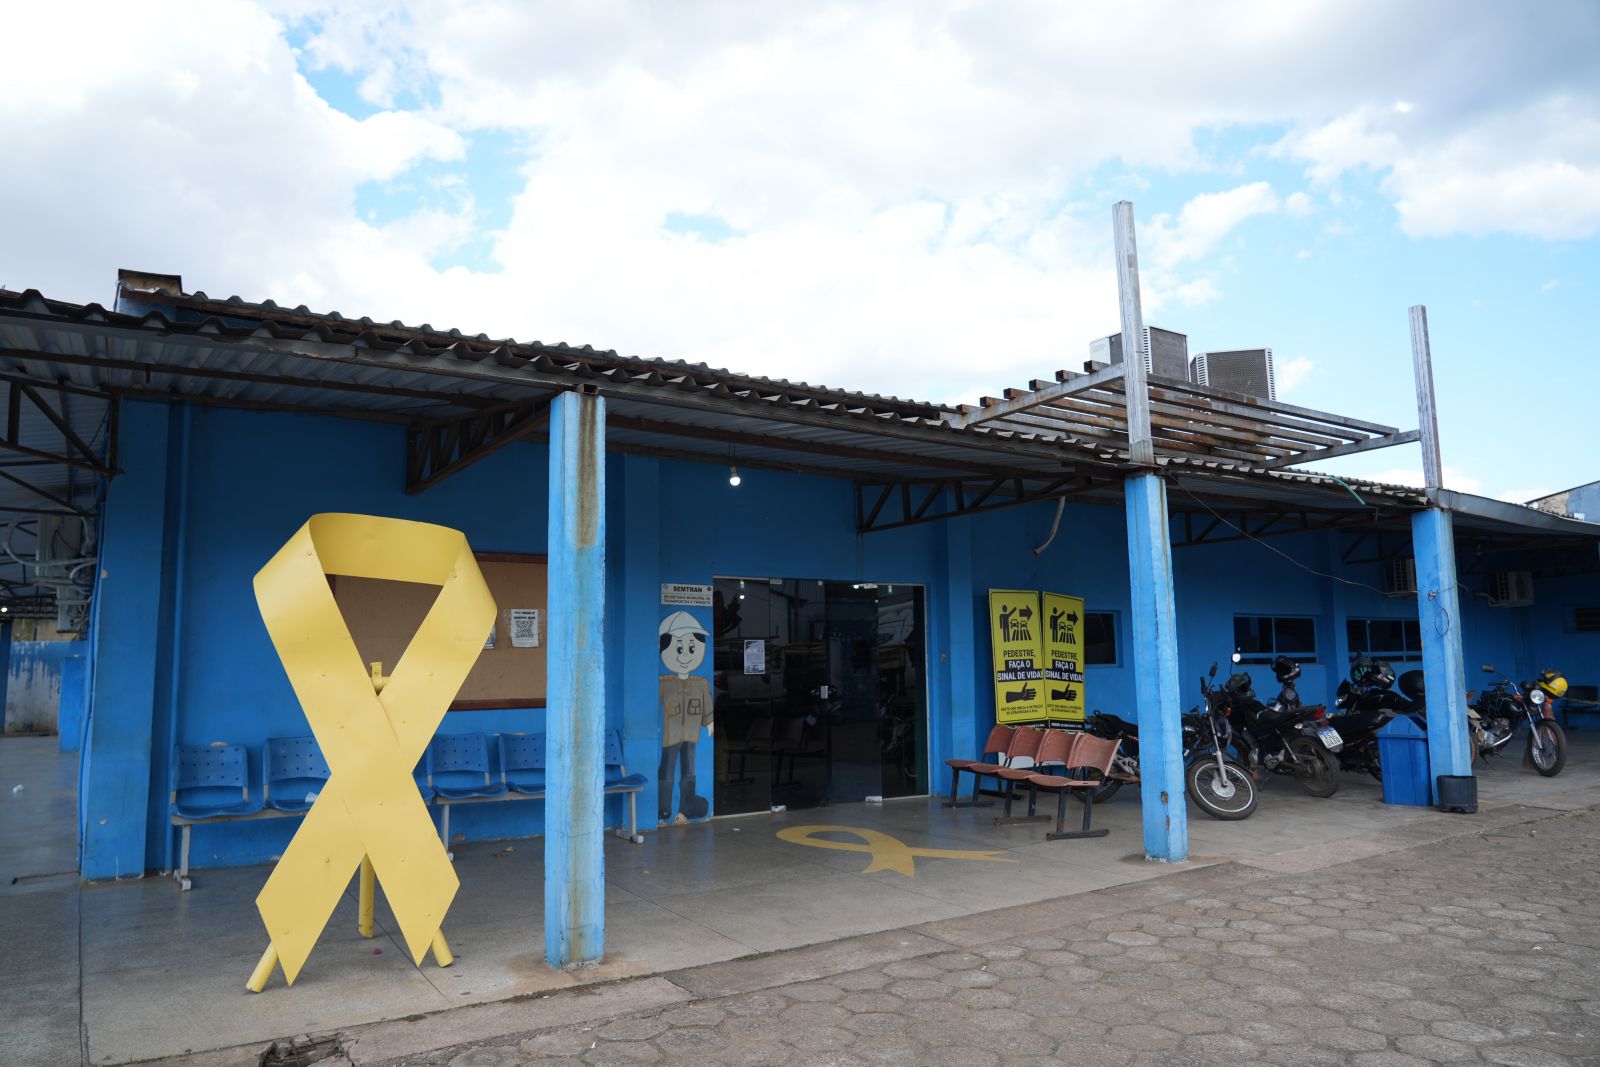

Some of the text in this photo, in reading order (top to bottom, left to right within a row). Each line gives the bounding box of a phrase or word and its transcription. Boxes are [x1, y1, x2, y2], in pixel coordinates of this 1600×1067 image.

[1004, 649, 1036, 658] PEDESTRE,
[1052, 650, 1078, 661] PEDESTRE,
[1008, 660, 1024, 670] FAÇA
[1055, 661, 1069, 670] FAÇA
[1026, 670, 1042, 679] VIDA!
[1070, 673, 1083, 681] VIDA!
